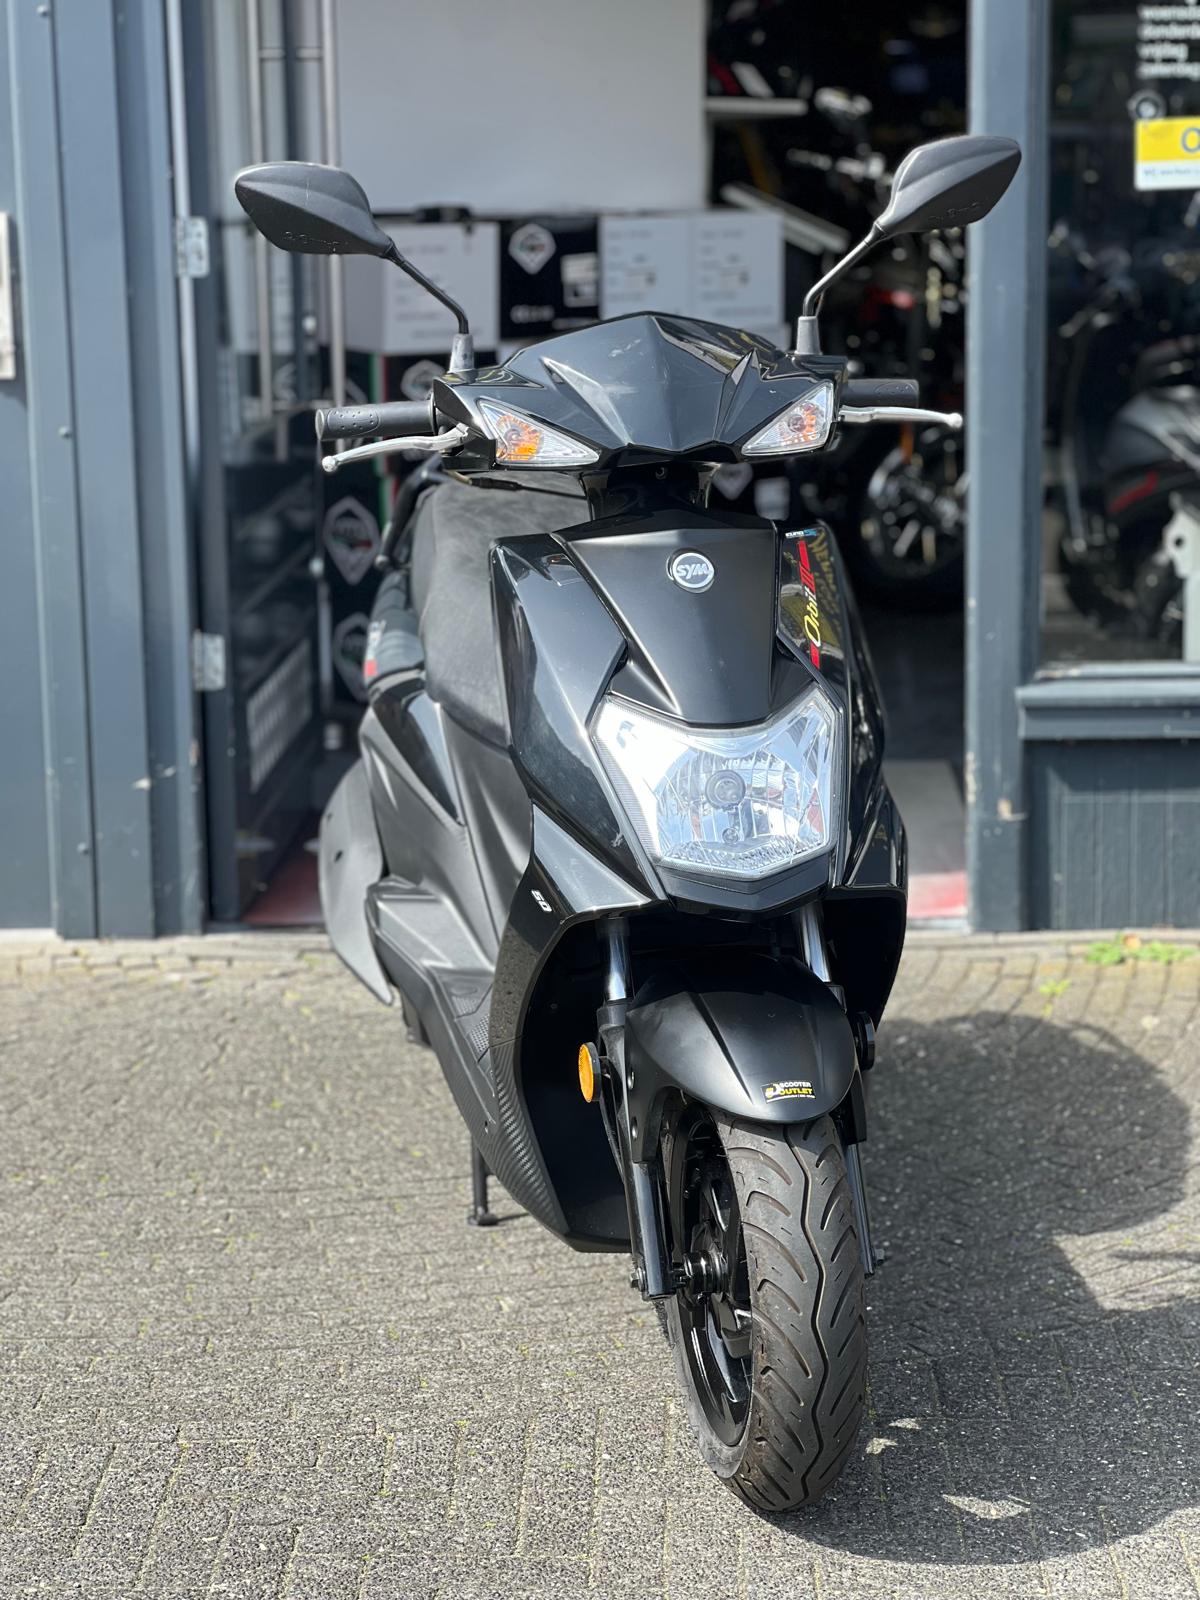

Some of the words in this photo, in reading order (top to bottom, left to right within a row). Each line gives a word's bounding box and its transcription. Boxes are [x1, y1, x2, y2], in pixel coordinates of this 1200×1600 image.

[677, 563, 709, 580] SYM
[803, 585, 821, 647] Orbit
[531, 889, 552, 911] 50
[779, 1087, 812, 1095] OUTLET
